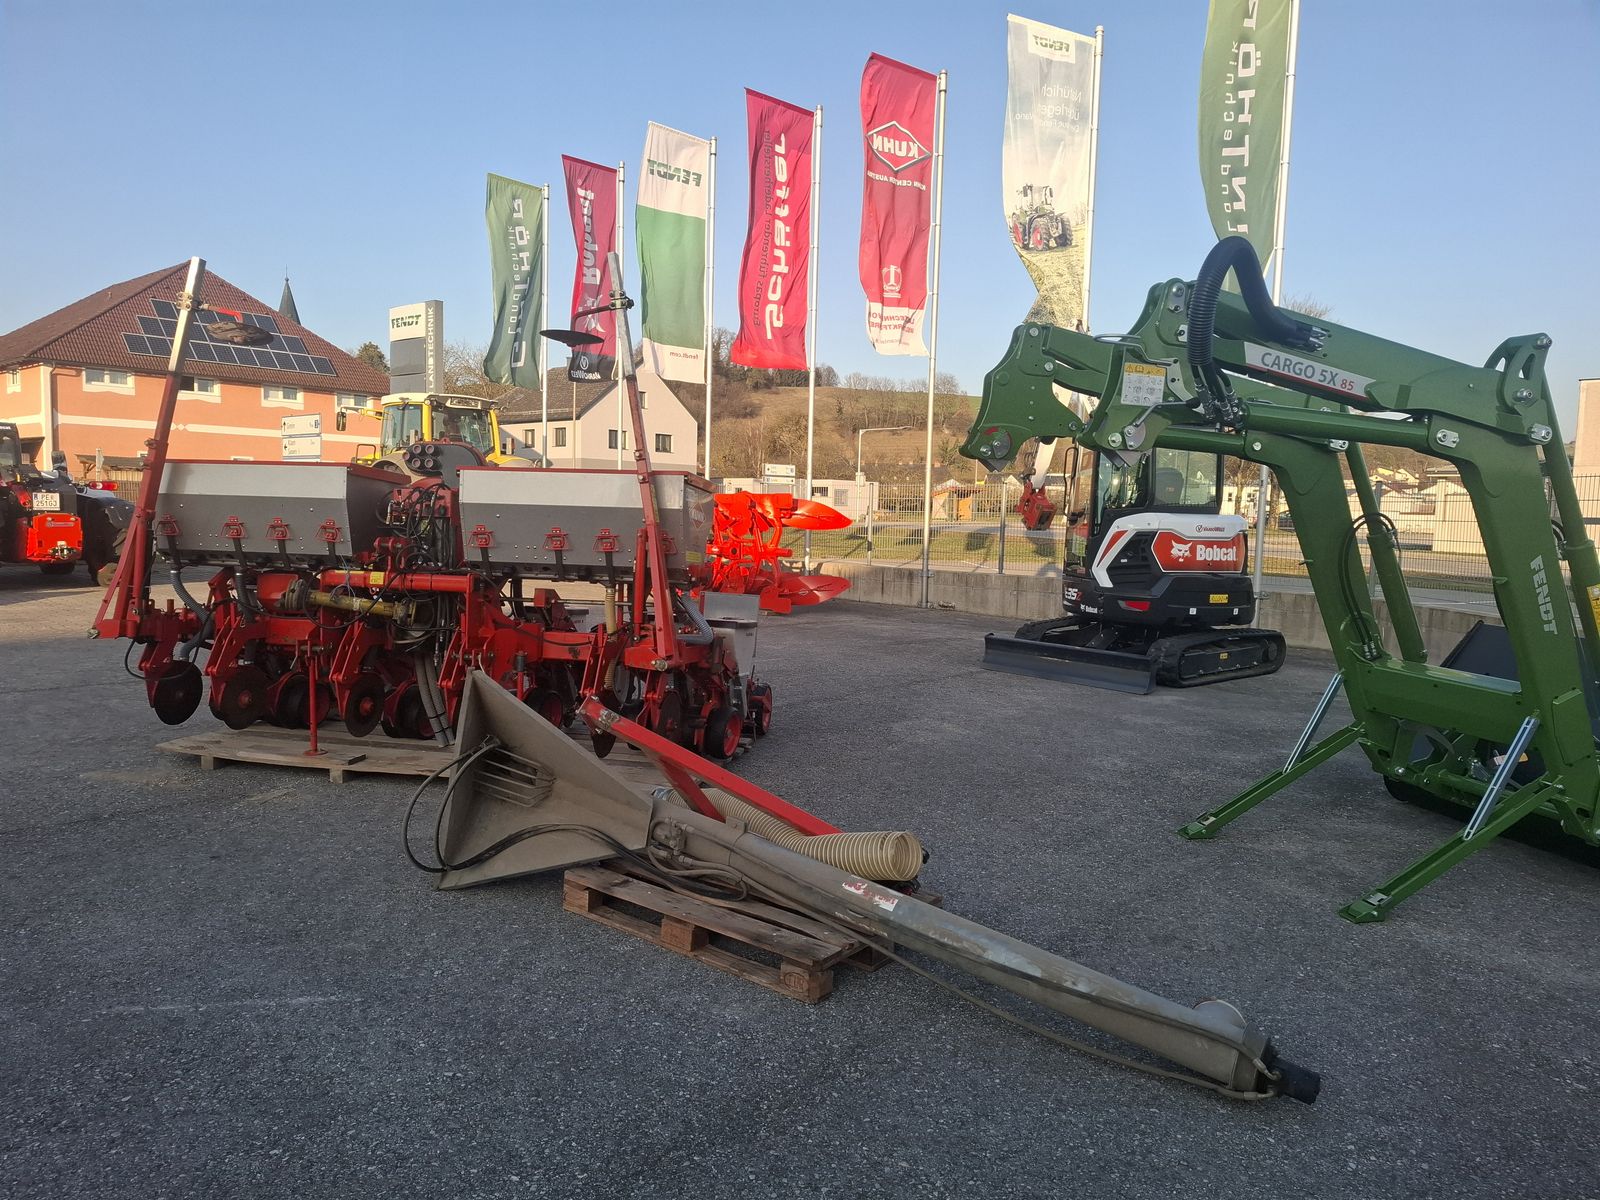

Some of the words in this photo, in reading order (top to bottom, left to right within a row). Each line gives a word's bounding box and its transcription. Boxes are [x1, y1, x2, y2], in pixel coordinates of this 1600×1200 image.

[391, 314, 422, 329] FENDT
[427, 306, 435, 388] LANDTECHNIK
[1260, 352, 1316, 379] CARGO
[1318, 368, 1339, 386] 5X
[1340, 378, 1355, 391] 85
[1196, 544, 1237, 561] Bobcat
[1530, 554, 1558, 635] FENDT
